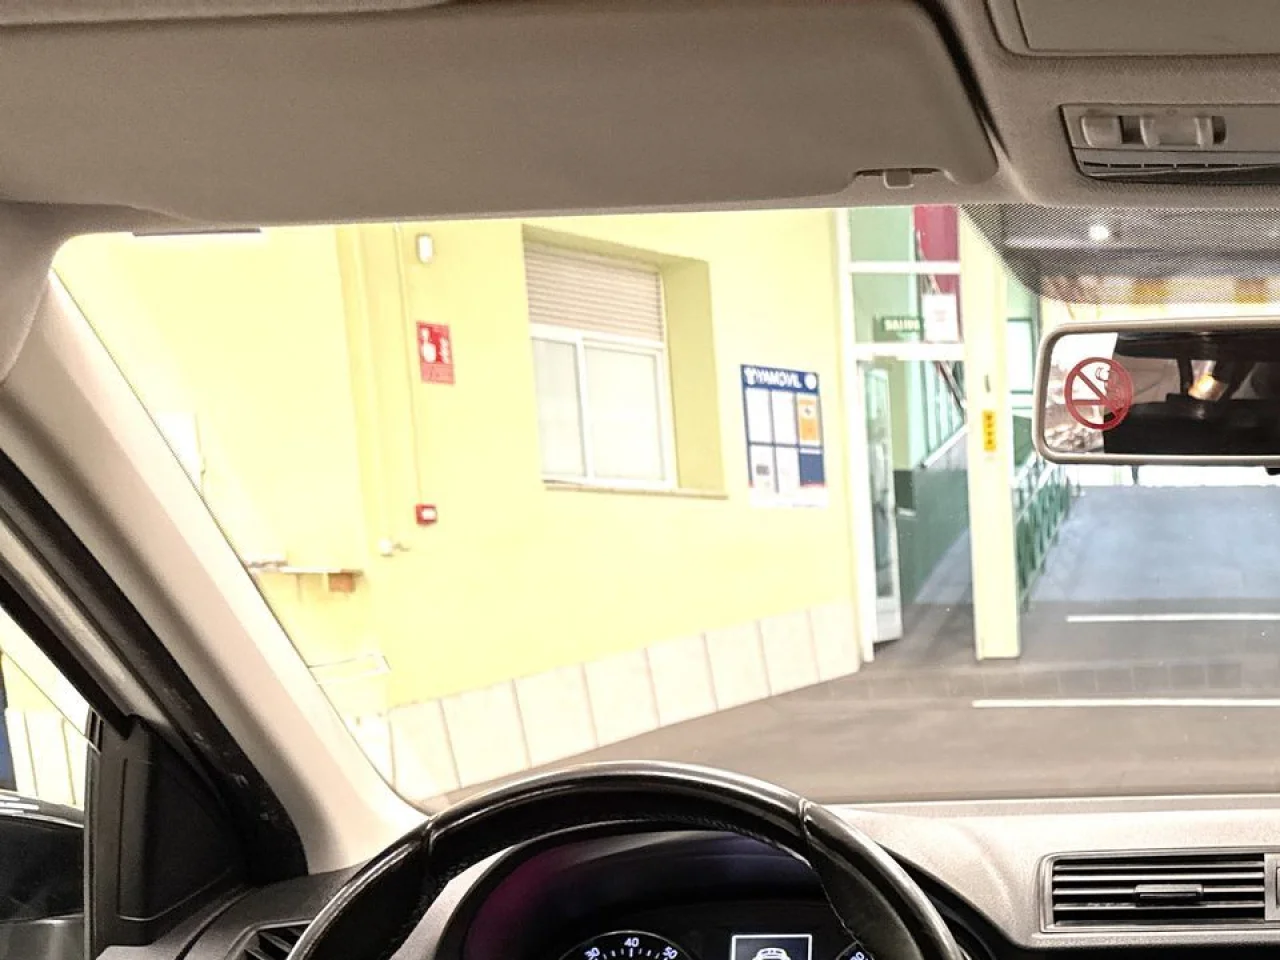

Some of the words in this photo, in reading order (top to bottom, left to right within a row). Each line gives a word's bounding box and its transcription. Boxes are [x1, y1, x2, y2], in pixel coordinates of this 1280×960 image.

[623, 936, 640, 948] 40
[584, 947, 601, 960] 30
[662, 946, 678, 960] 50
